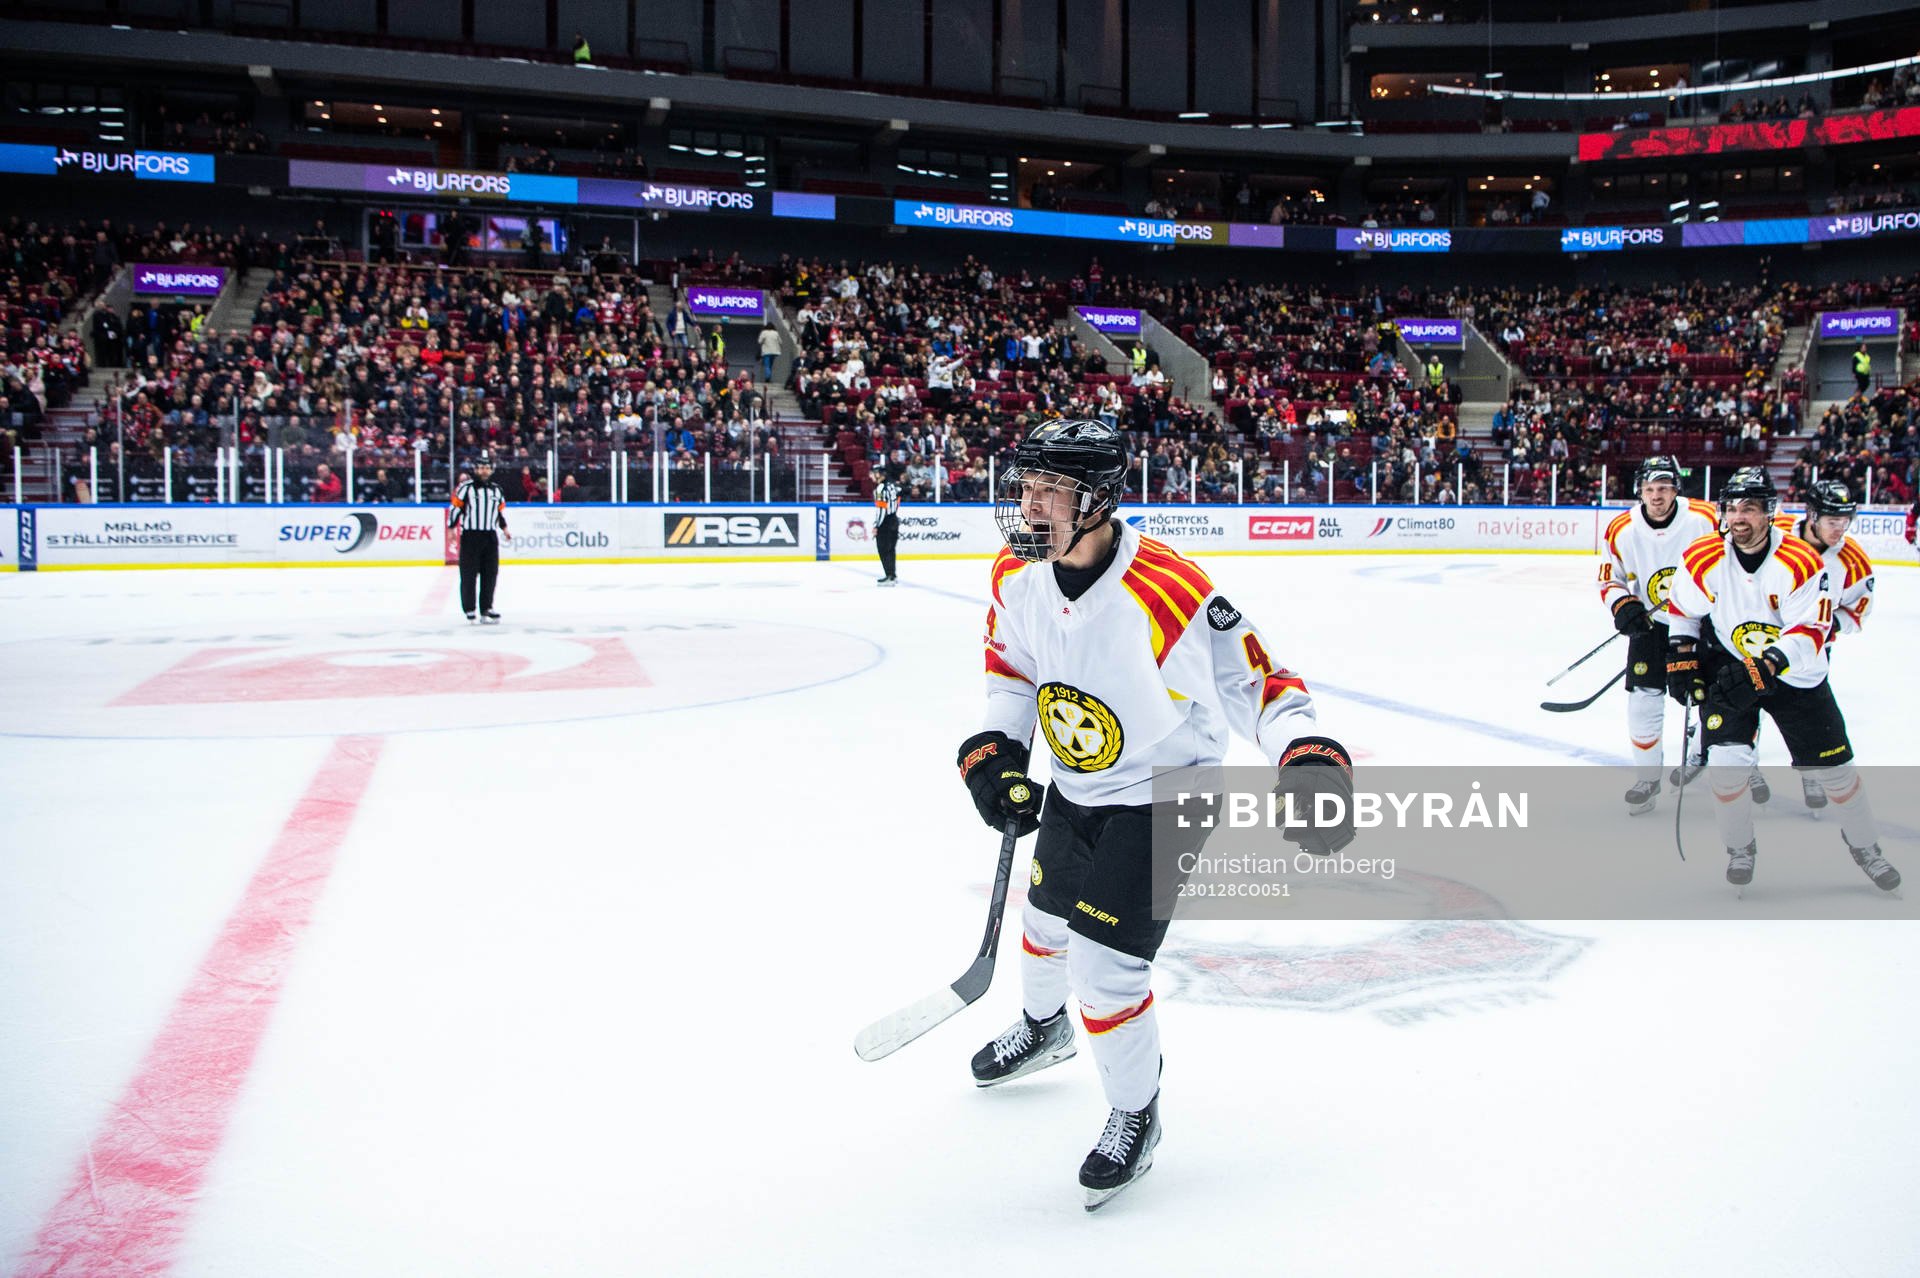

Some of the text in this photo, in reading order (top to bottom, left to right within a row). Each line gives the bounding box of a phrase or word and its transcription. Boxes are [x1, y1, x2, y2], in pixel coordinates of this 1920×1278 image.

[82, 151, 190, 175] BJURFORS
[413, 170, 511, 194] BJURFORS
[665, 188, 754, 209] BJURFORS
[935, 206, 1014, 228] BJURFORS
[1137, 221, 1213, 240] BJURFORS
[1581, 228, 1664, 246] BJURFORS
[1374, 231, 1452, 248] BJURFORS
[156, 271, 219, 288] BJURFORS
[707, 294, 758, 309] BJURFORS
[1093, 313, 1137, 327] BJURFORS
[1840, 316, 1892, 330] BJURFORS
[1411, 324, 1457, 337] BJURFORS
[104, 520, 172, 532] MALMÖ
[1149, 513, 1209, 525] HÖGTRYCKS
[1319, 518, 1339, 527] ALL
[1397, 517, 1455, 530] Climat80
[21, 510, 32, 559] CCM
[279, 525, 352, 541] SUPER
[695, 516, 796, 544] RSA
[817, 508, 828, 551] CCM
[1150, 525, 1224, 536] TJÄNST SYD AB
[1251, 521, 1312, 535] CCM
[1318, 528, 1343, 538] OUT.
[1477, 516, 1579, 539] navigator
[47, 533, 239, 544] STÄLLNINGSSERVICE
[921, 531, 961, 541] UNGDOM
[1208, 605, 1220, 617] EN
[1212, 609, 1229, 623] BRA
[1217, 610, 1240, 629] START
[1745, 622, 1762, 632] 1912
[1241, 631, 1275, 679] 4
[1053, 685, 1079, 703] 1912
[1074, 899, 1120, 928] BAUER
